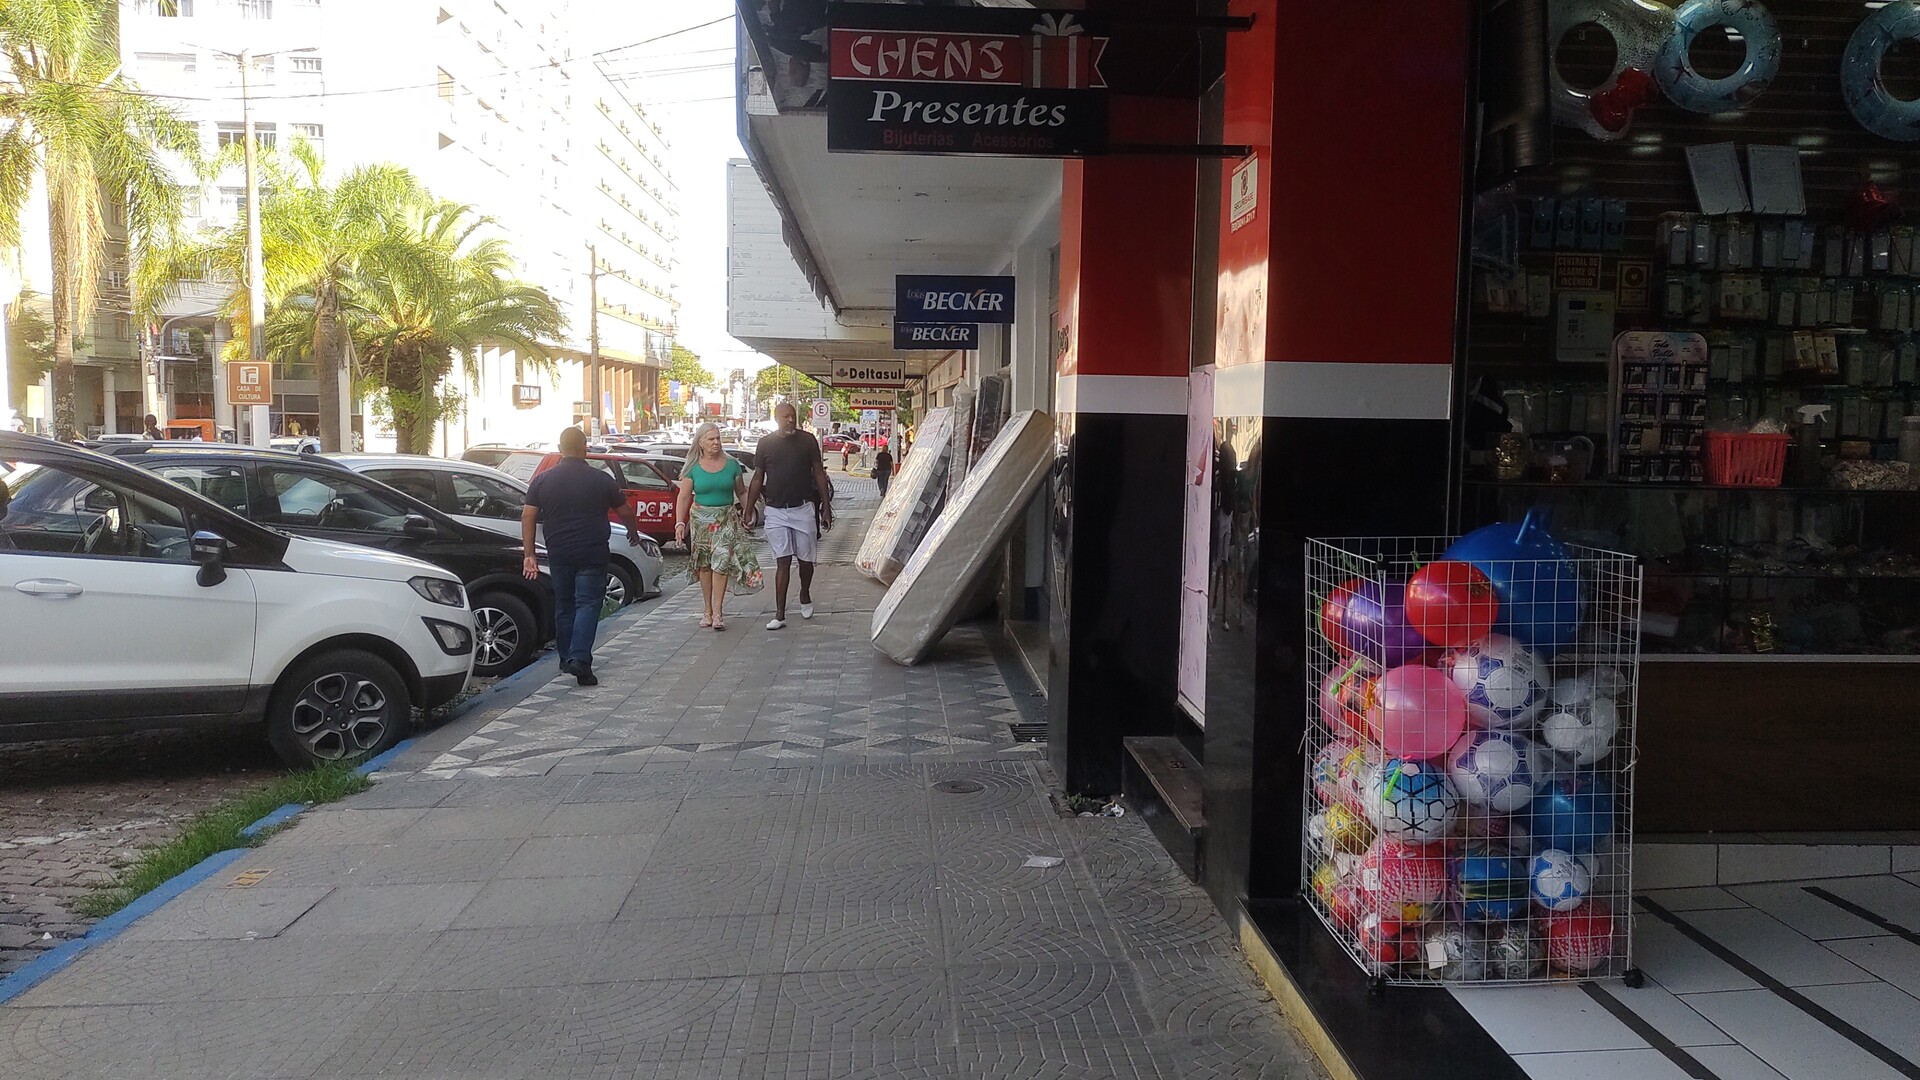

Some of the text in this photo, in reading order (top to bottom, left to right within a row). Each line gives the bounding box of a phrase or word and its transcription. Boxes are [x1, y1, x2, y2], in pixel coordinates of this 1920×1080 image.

[850, 35, 1005, 80] CHENS
[867, 89, 1067, 127] Presentes
[882, 129, 1055, 149] Bijuterias Acessórios
[1558, 256, 1599, 266] CENTRAL DE
[1558, 266, 1598, 277] ALARME DE
[923, 289, 1004, 311] BECKER
[912, 326, 970, 341] BECKER
[849, 367, 902, 380] Deltasul
[862, 398, 894, 406] Deltasul
[818, 405, 825, 414] E
